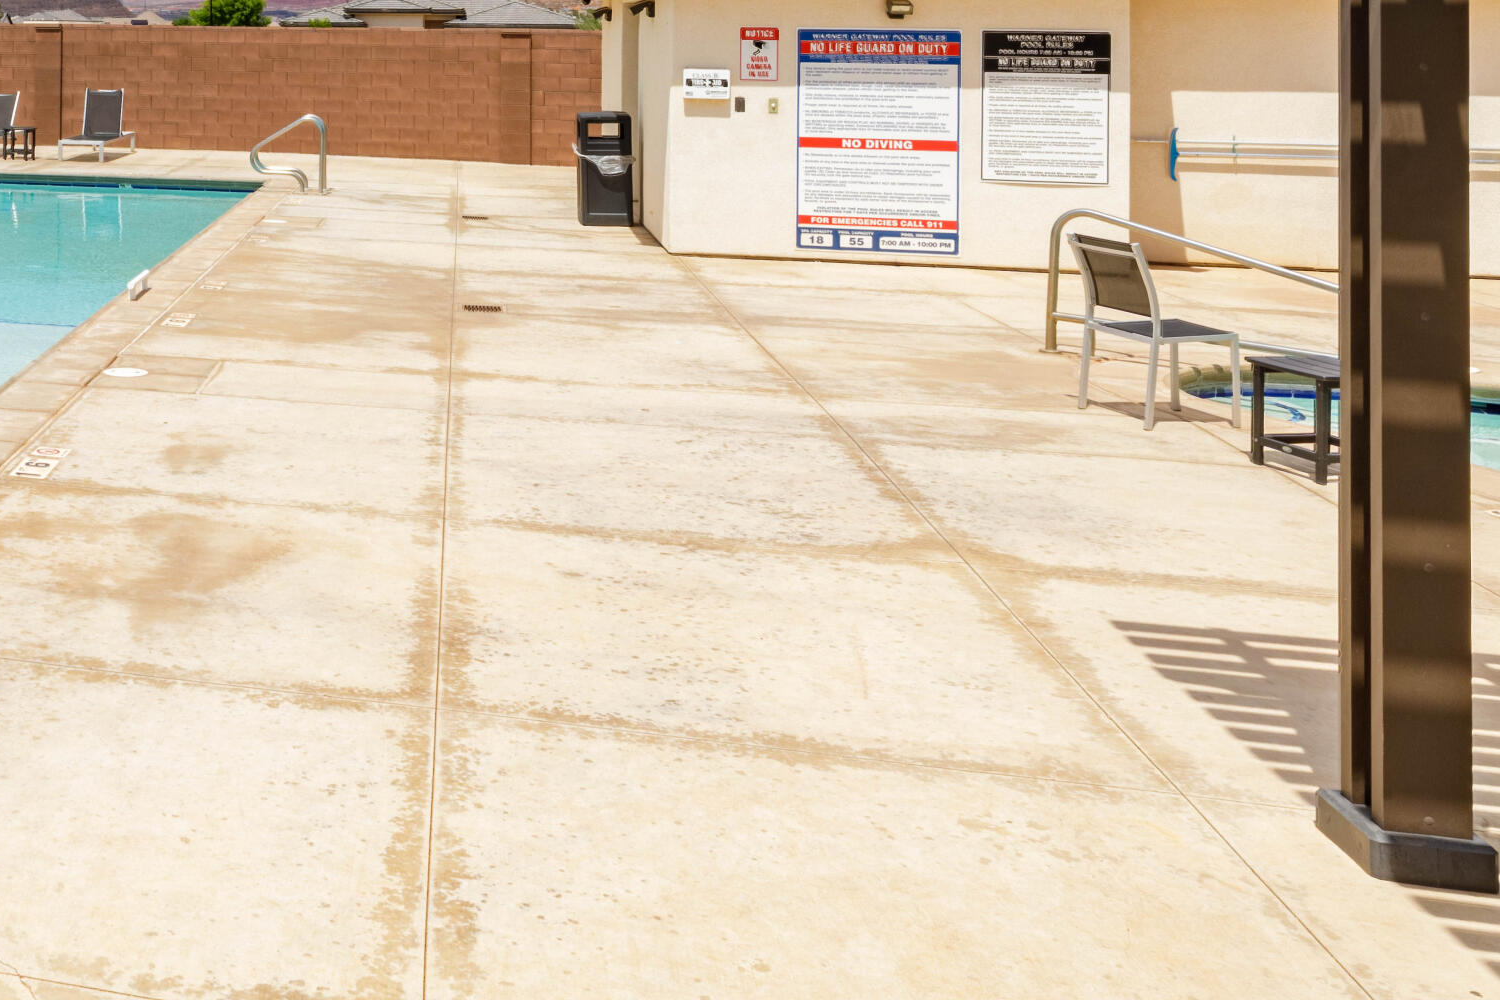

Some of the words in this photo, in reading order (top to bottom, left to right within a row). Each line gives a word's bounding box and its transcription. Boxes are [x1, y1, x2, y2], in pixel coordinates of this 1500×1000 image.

[1006, 34, 1043, 42] WARNER
[810, 42, 825, 52] NO
[828, 42, 853, 53] LIFE
[856, 43, 895, 53] GUARD
[899, 43, 914, 53] ON
[918, 43, 948, 54] DUTY
[997, 58, 1009, 66] NO
[1011, 58, 1028, 66] LIFE
[1030, 58, 1058, 67] GUARD
[1073, 59, 1095, 67] DUTY
[841, 139, 861, 148] NO
[865, 139, 914, 149] DIVING
[811, 216, 829, 224] FOR
[831, 217, 898, 227] EMERGENCIES
[900, 219, 924, 227] CALL
[926, 220, 943, 228] 911
[809, 236, 824, 244] 18
[849, 237, 864, 246] 55
